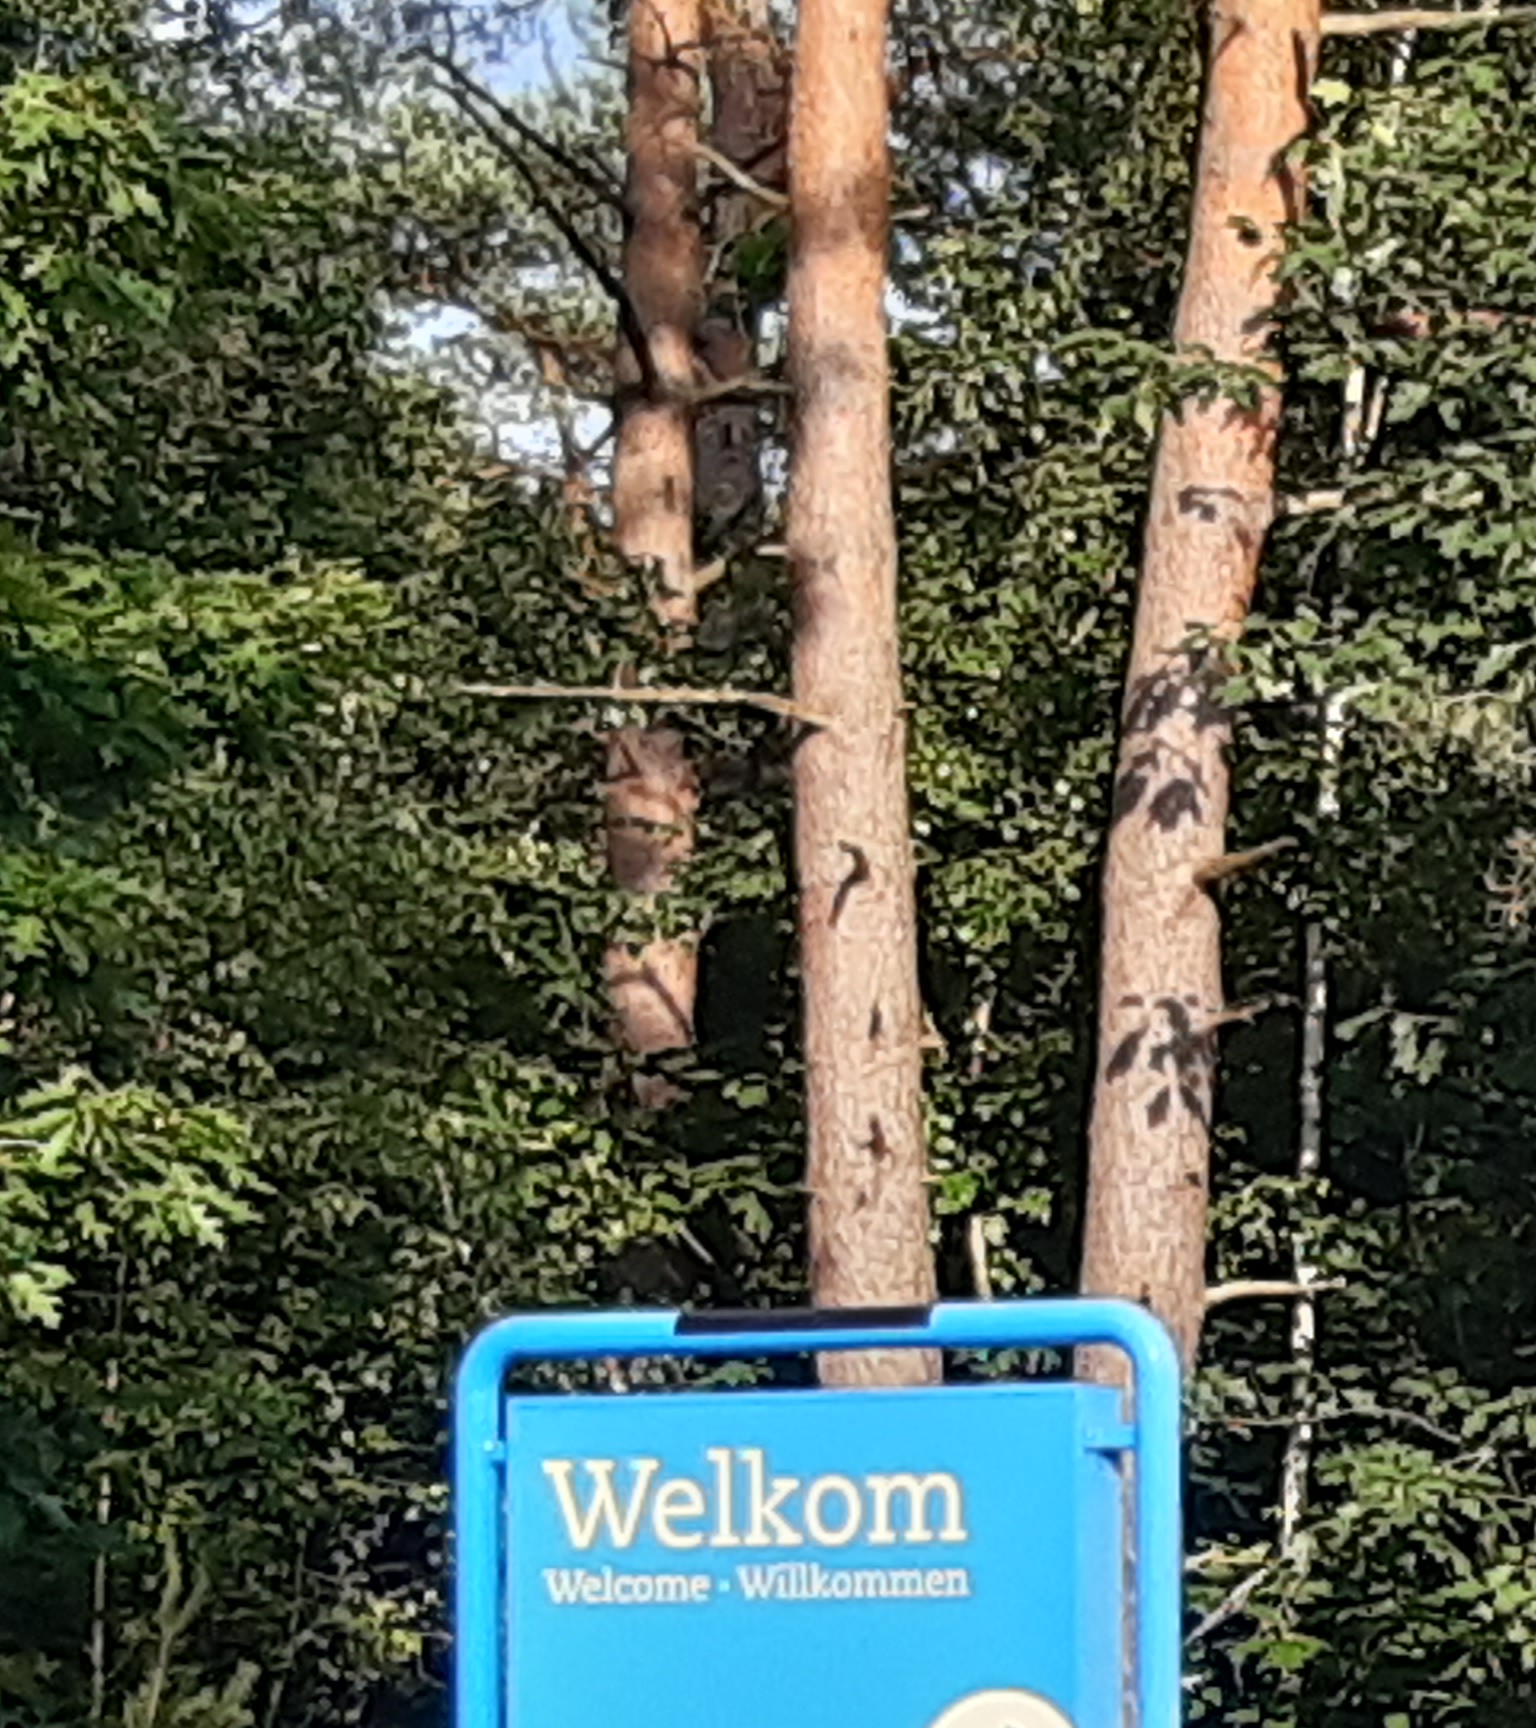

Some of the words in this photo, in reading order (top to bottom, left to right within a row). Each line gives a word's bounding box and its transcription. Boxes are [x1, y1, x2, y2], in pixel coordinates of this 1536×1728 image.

[542, 1446, 968, 1550] Welkom
[543, 1565, 710, 1603] Welcome
[736, 1560, 970, 1598] Willkommen
